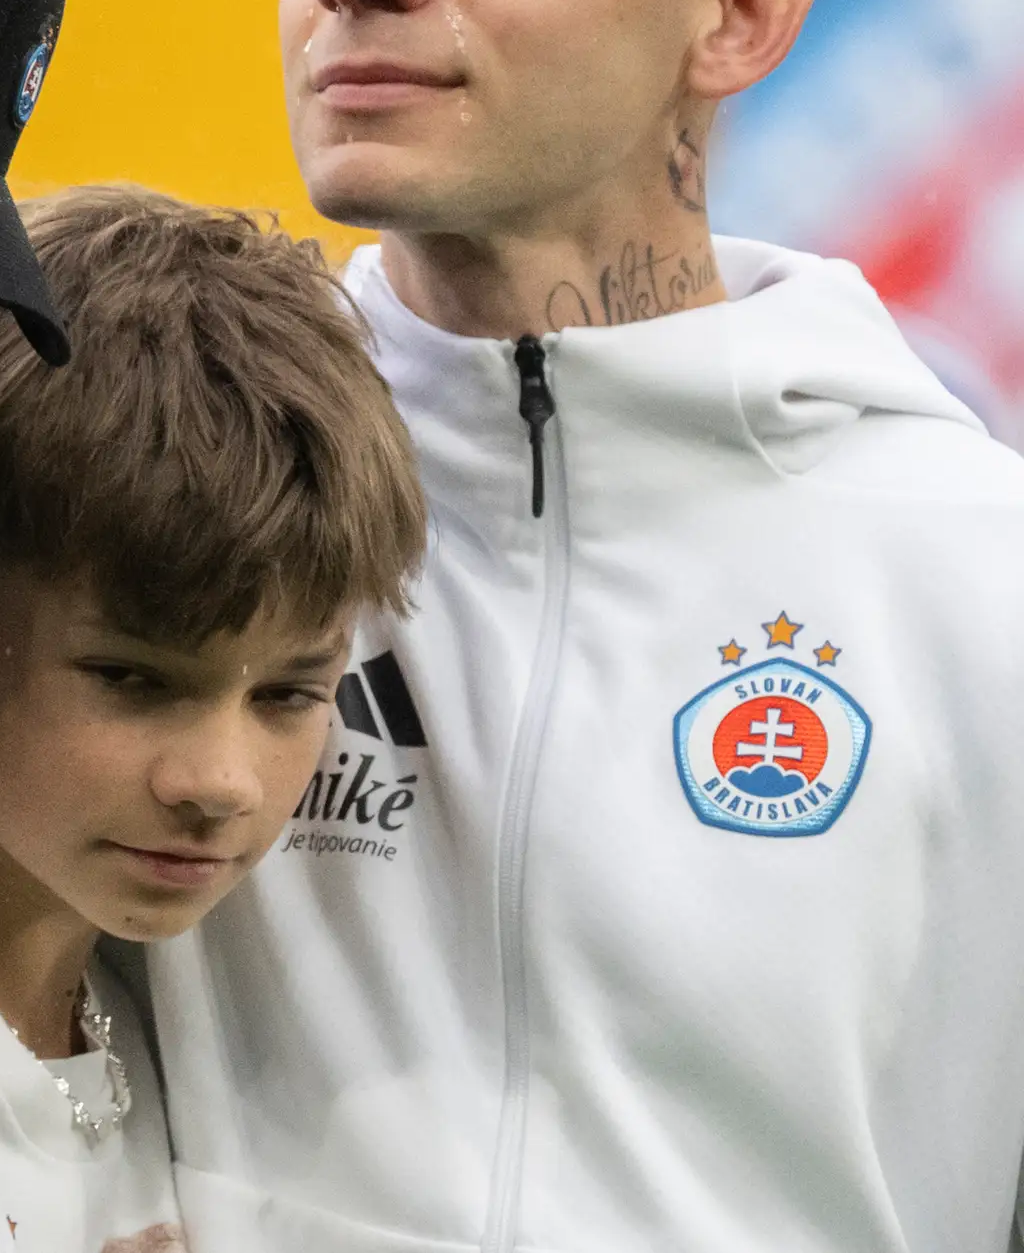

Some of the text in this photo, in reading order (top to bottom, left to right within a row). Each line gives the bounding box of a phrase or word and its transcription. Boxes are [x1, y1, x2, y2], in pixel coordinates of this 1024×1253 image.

[734, 677, 823, 705] SLOVAN
[703, 776, 834, 821] BRATISLAVA
[280, 828, 398, 862] je tipovanie
